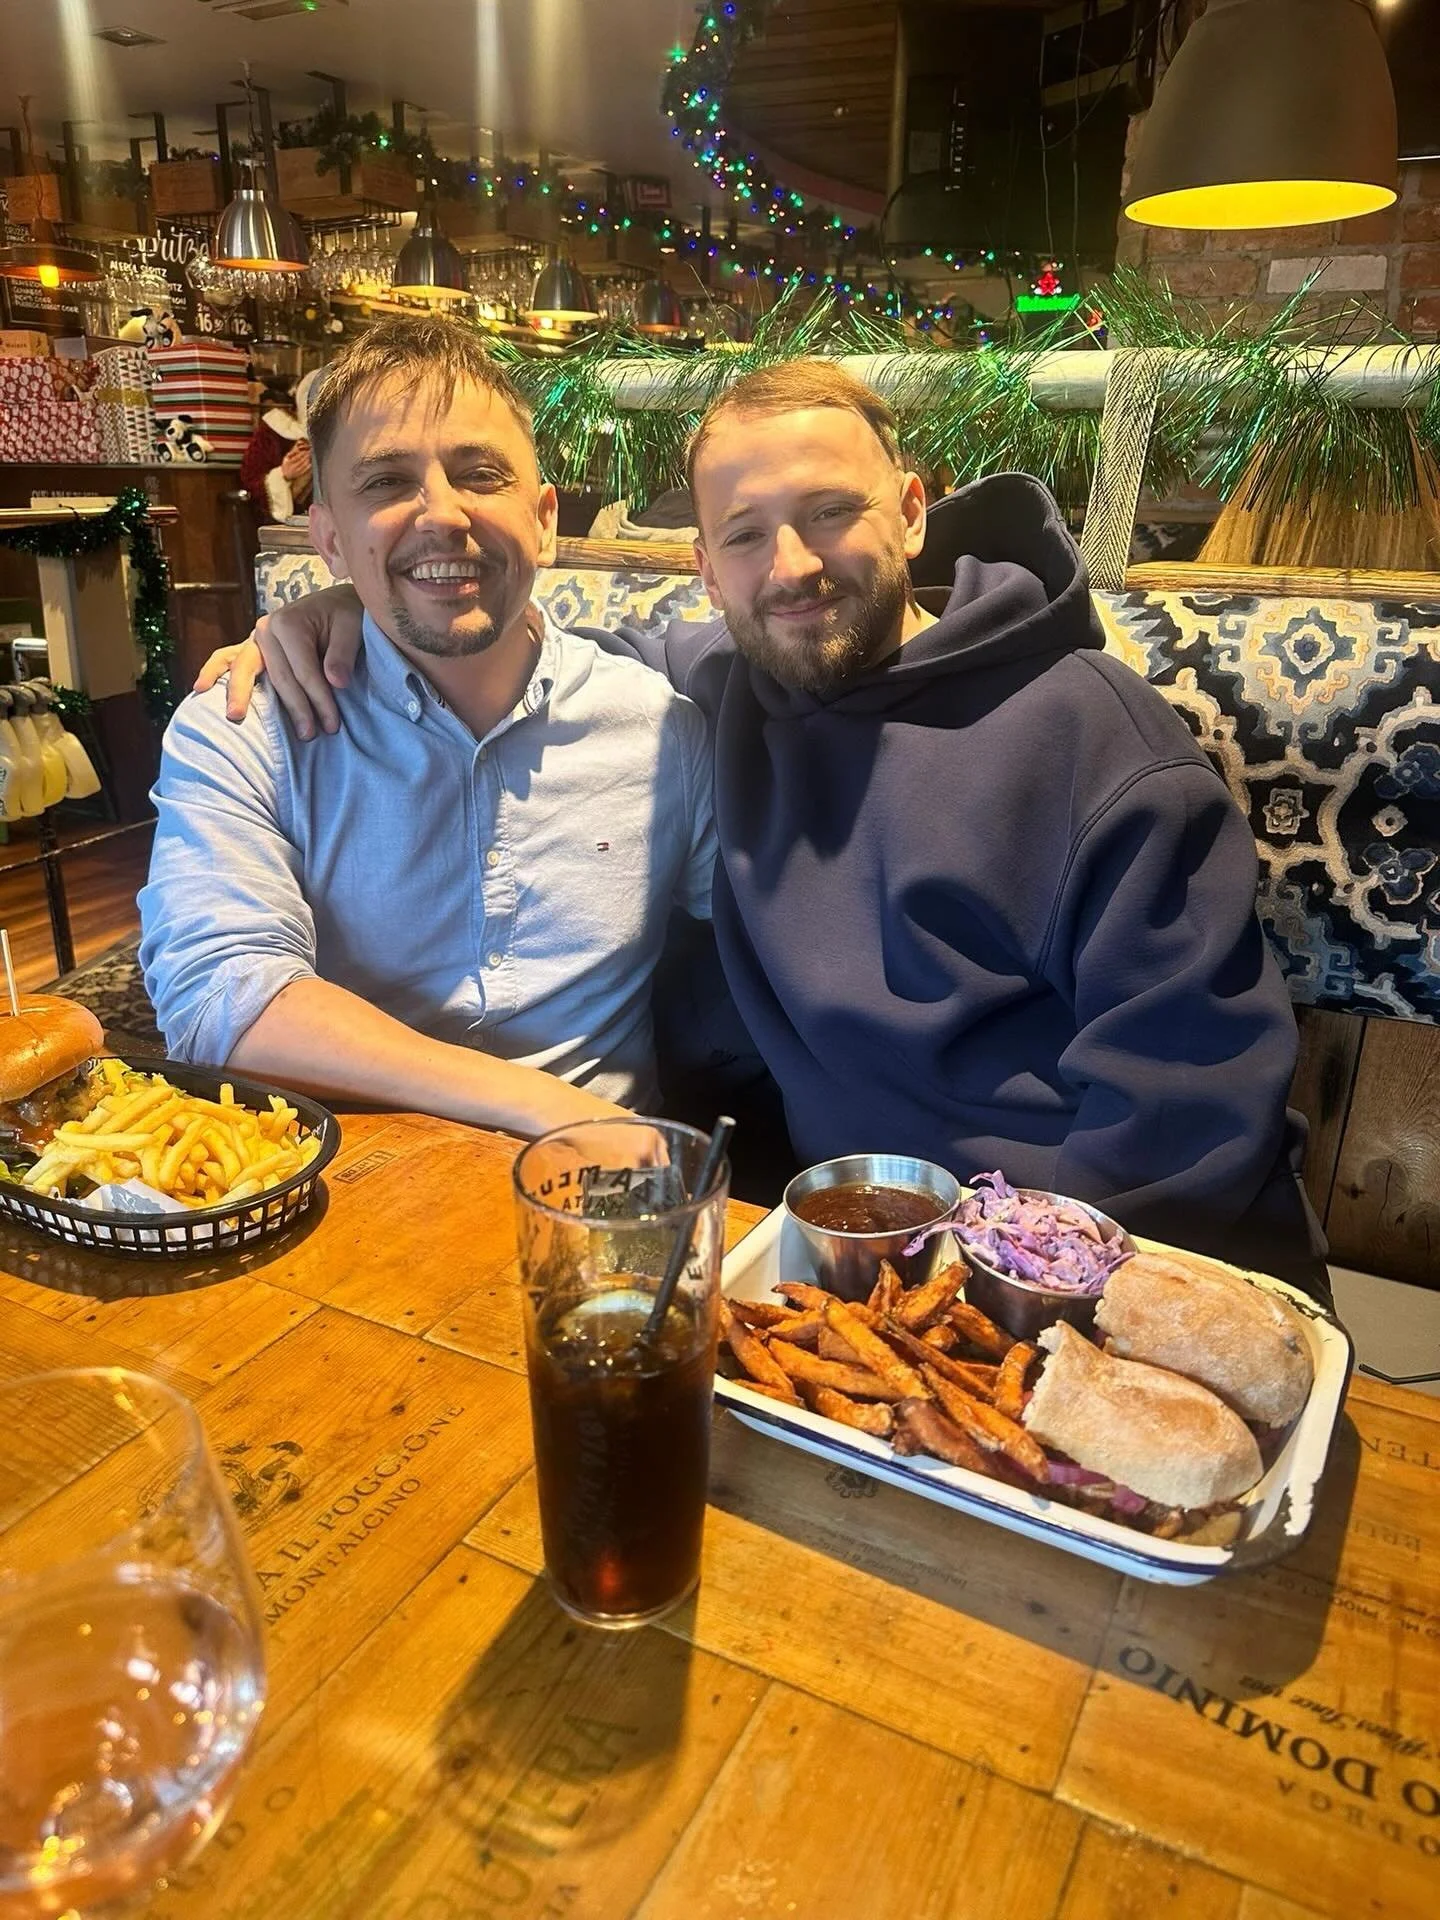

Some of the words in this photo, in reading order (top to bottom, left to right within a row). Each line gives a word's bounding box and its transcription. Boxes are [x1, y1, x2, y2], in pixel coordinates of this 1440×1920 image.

[265, 1477, 421, 1626] MONTALCINO
[276, 1537, 321, 1562] IL
[1118, 1645, 1382, 1803] DOMINIO
